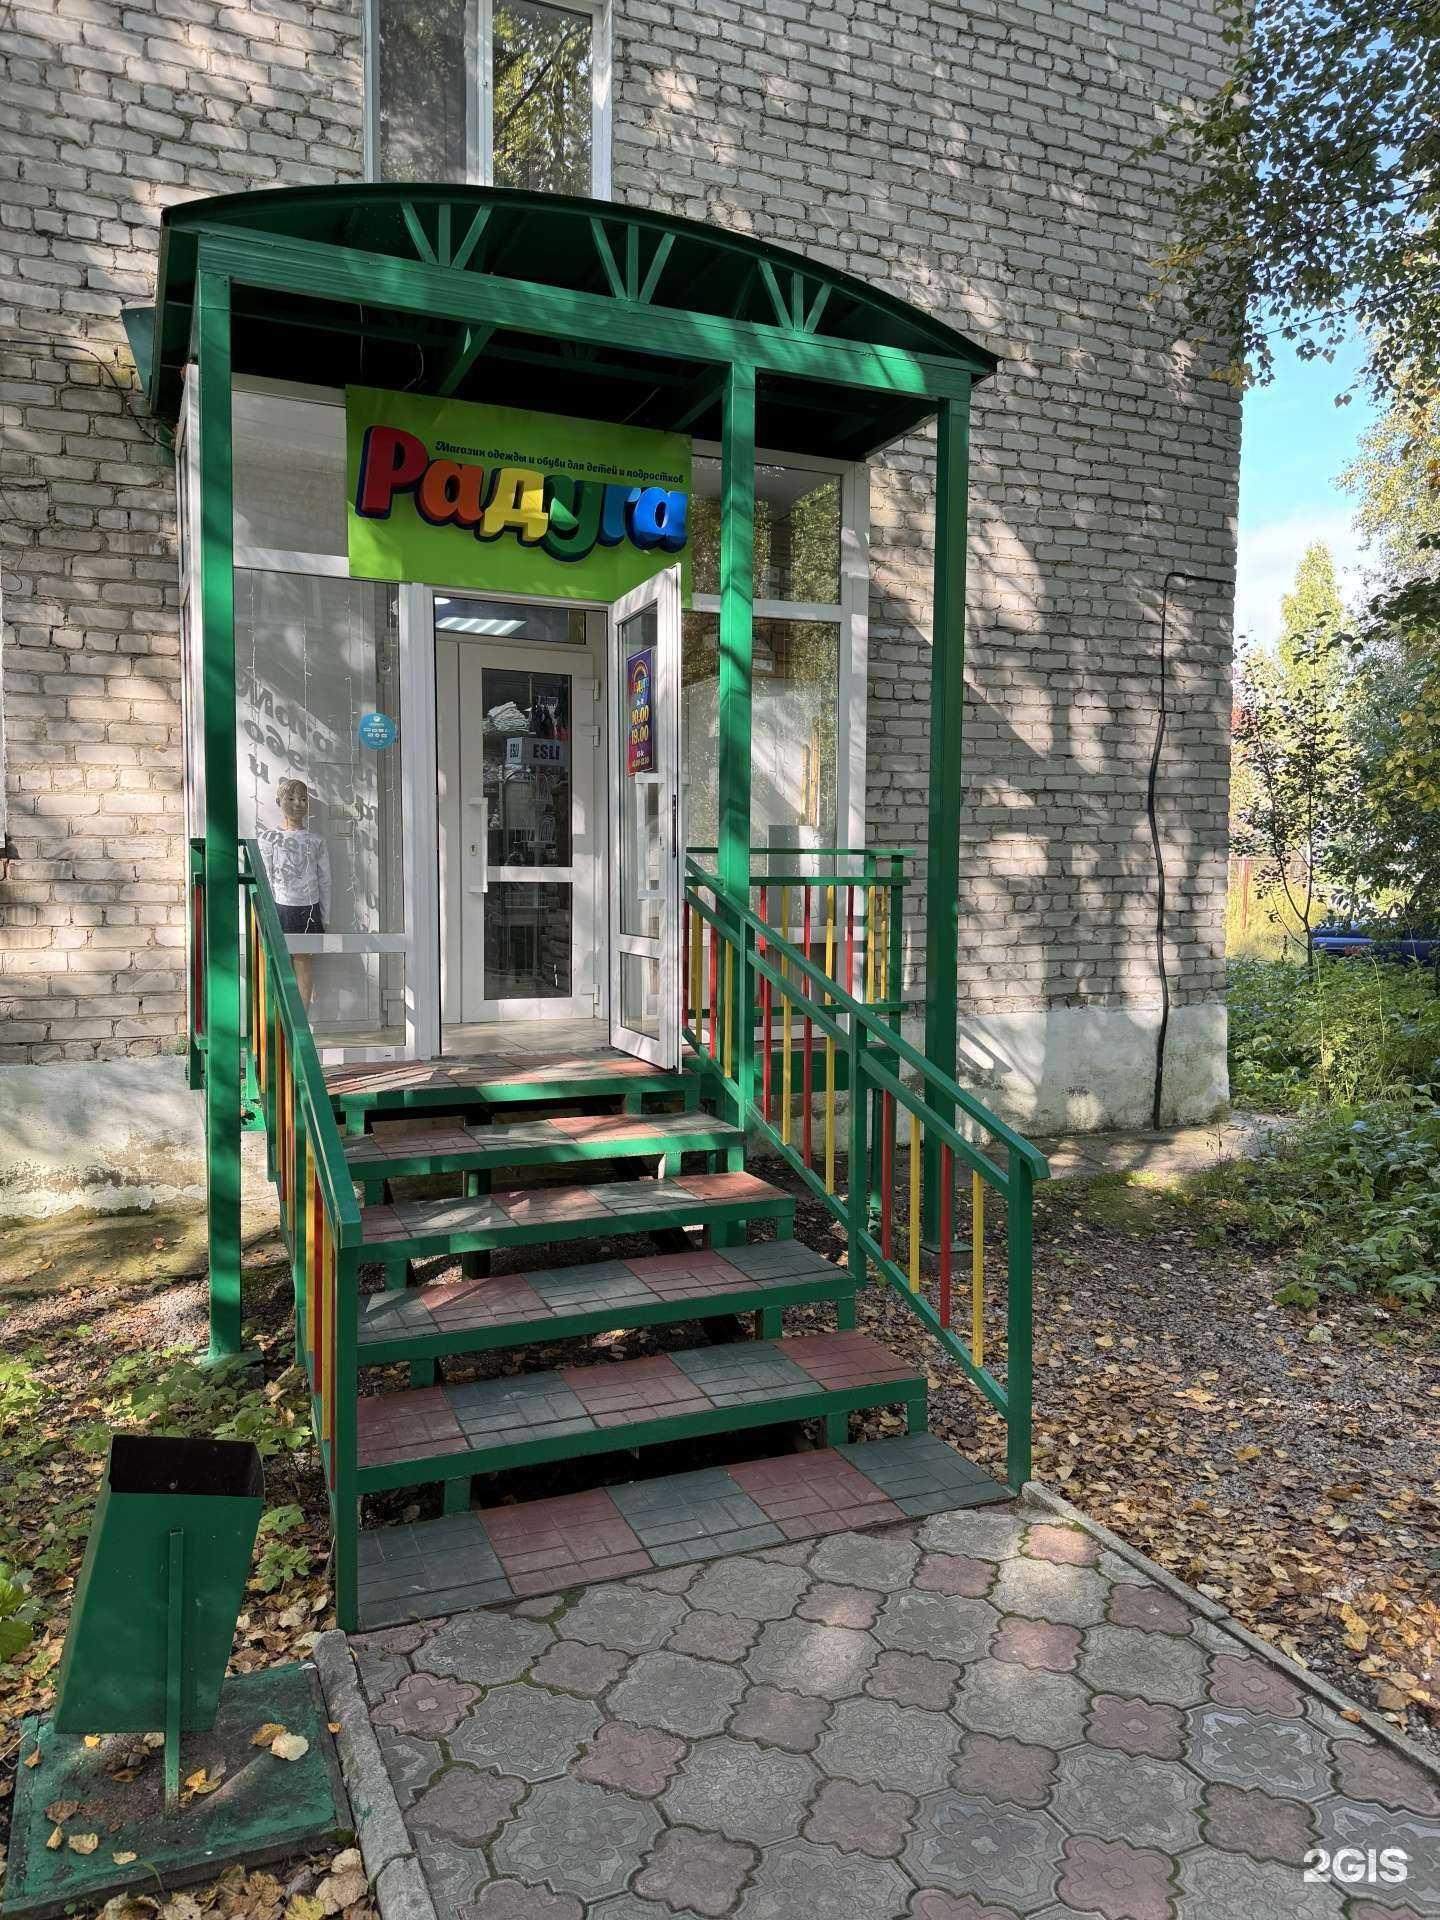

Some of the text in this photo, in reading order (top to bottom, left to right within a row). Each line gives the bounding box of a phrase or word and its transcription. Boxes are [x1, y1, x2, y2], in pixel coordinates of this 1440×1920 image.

[434, 440, 684, 484] Магазин одежды и обуви для детей и подростков
[355, 424, 688, 562] Радуга
[532, 743, 560, 761] ESLI
